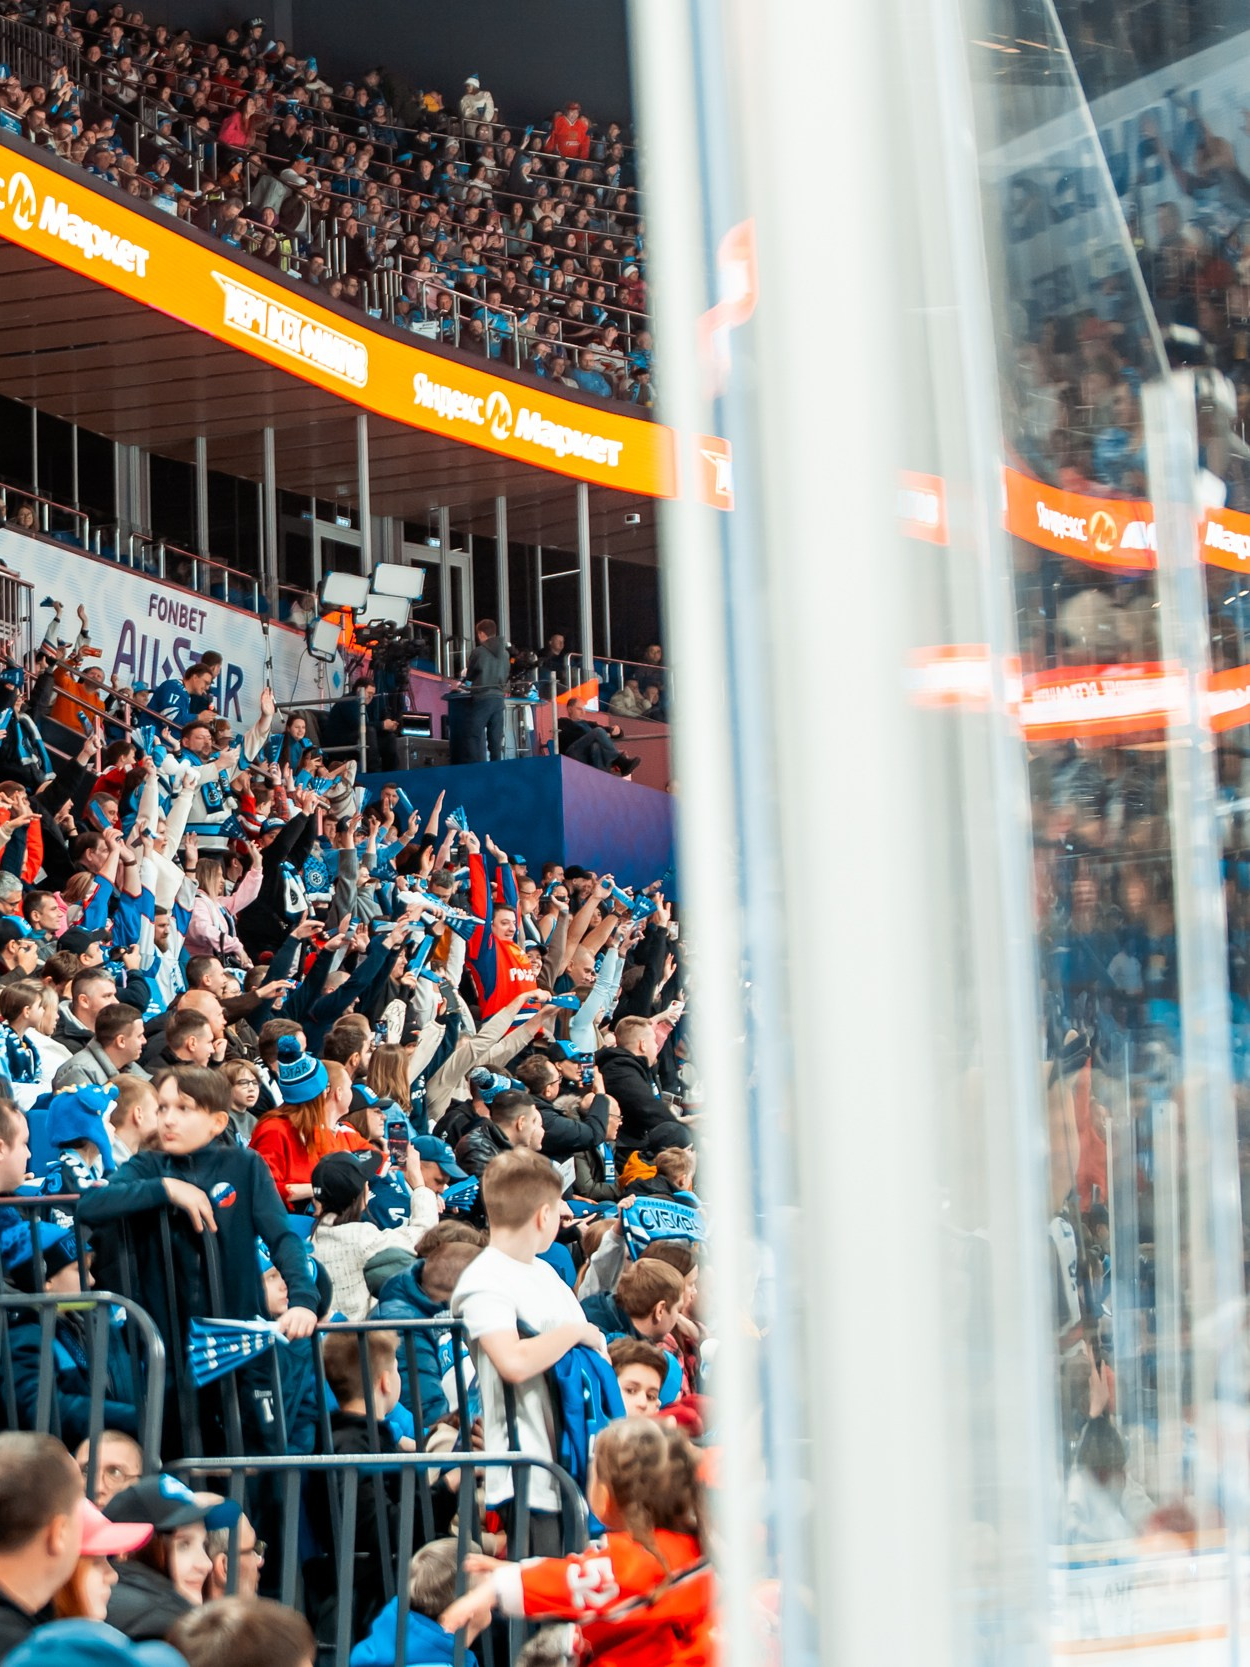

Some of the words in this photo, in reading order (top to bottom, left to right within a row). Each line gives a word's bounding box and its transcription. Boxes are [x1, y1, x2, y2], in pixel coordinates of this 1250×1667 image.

[38, 195, 150, 278] Маркет
[413, 372, 485, 426] Яндекс
[513, 407, 623, 467] Маркет
[148, 593, 207, 634] FONBET
[168, 692, 181, 705] 17
